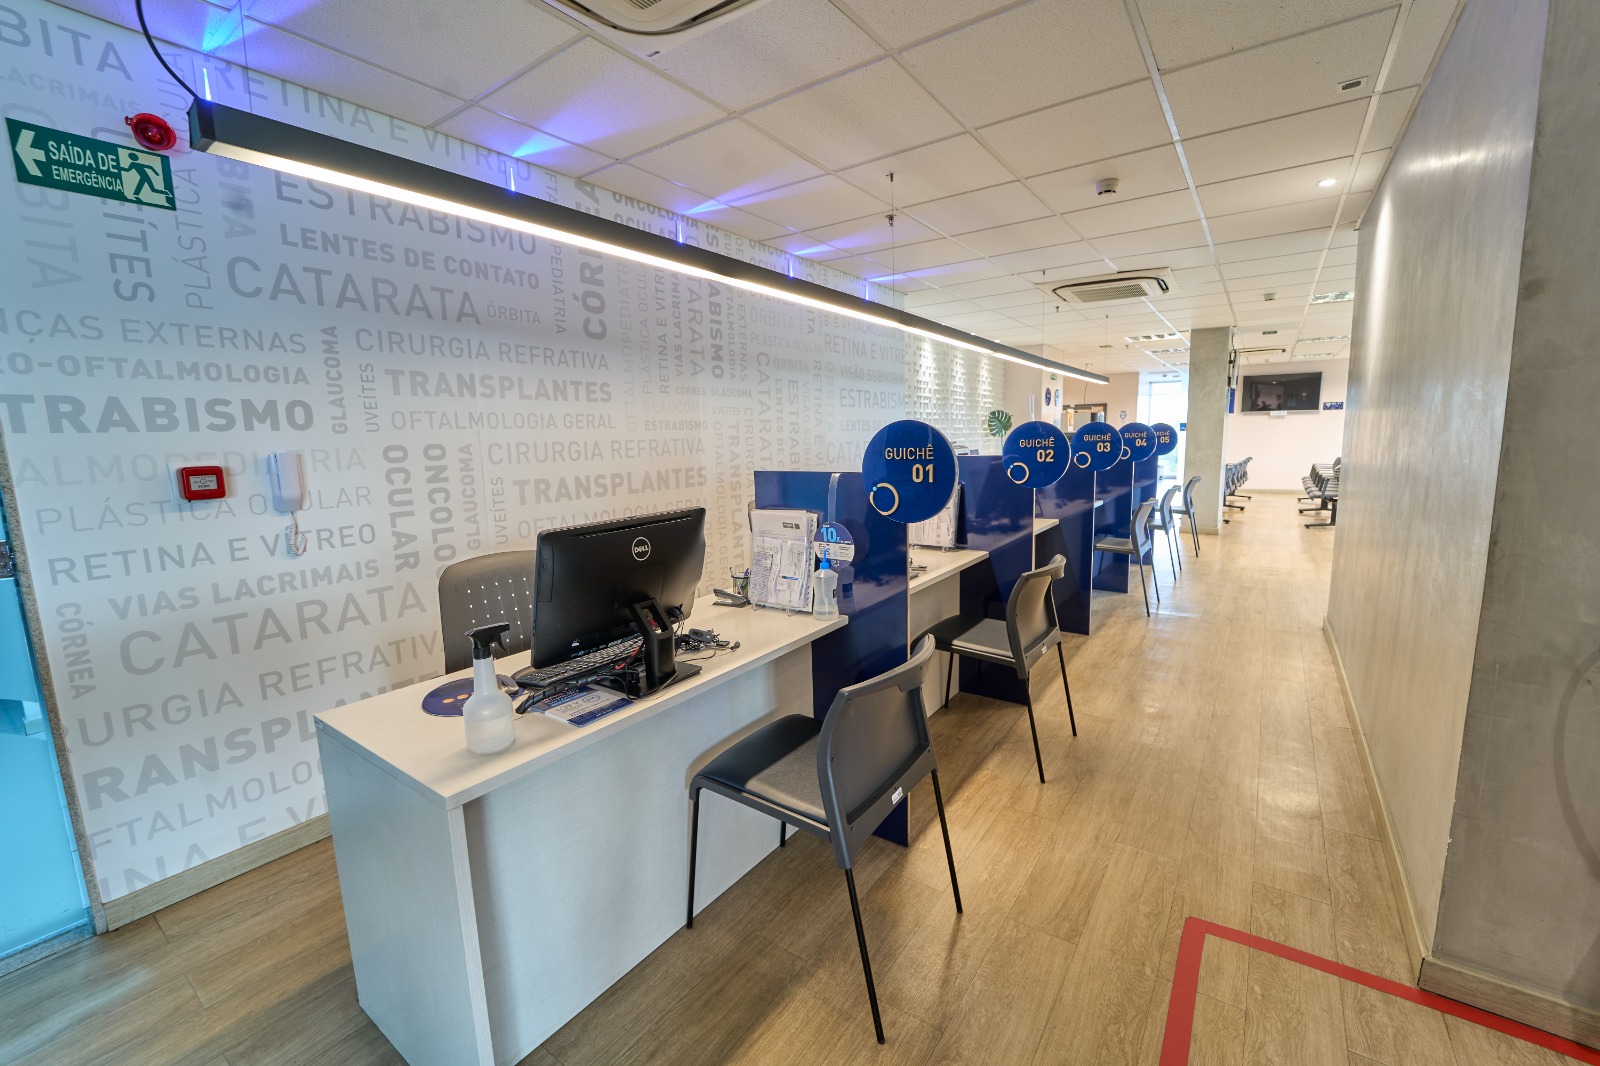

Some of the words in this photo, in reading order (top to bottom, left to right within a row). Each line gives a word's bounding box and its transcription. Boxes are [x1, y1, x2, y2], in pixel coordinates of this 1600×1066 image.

[0, 66, 141, 116] ACRIMAIS
[389, 117, 409, 143] E
[48, 140, 95, 168] SAÍDA
[99, 152, 119, 173] DE
[52, 166, 124, 193] EMERGÊNCIA
[274, 170, 537, 255] ESTRABISMO
[171, 167, 214, 311] PLÁSTICA
[280, 223, 396, 263] LENTES
[404, 247, 435, 271] DE
[444, 256, 539, 289] CONTATO
[226, 256, 482, 325] CATARATA
[487, 300, 541, 325] ÓRBITA
[657, 317, 667, 327] E
[750, 300, 796, 330] ÓRBITA
[120, 318, 306, 353] EXTERNAS
[355, 328, 491, 360] CIRURGIA
[499, 342, 609, 371] REFRATIVA
[738, 304, 748, 381] EXTERNAS
[751, 332, 791, 351] PLÁSTICA
[794, 339, 823, 354] OCULAR
[824, 333, 867, 358] RETINA
[871, 342, 877, 360] E
[0, 352, 310, 386] O-OFTALMOLOGIA
[637, 318, 653, 394] PLÁSTICA
[656, 333, 670, 394] RETINA
[674, 343, 684, 377] VIAS
[773, 353, 810, 374] ÓRBITA
[839, 363, 865, 380] VISÃO
[320, 325, 348, 435] GLAUCOMA
[384, 368, 612, 403] TRANSPLANTES
[676, 383, 706, 396] CÓRNEA
[711, 386, 752, 399] GLAUCOMA
[813, 360, 823, 427] RETINA
[2, 393, 314, 434] TRABISMO
[358, 363, 380, 433] UVEÍTES
[643, 400, 707, 414] GLAUCOMA
[712, 404, 740, 416] UVEÍTES
[756, 352, 773, 471] CATARAT
[775, 378, 784, 433] LENTES
[391, 411, 557, 430] OFTALMOLOGIA
[563, 413, 616, 431] GERAL
[645, 420, 708, 432] ESTRABISMO
[787, 379, 801, 471] ESTRAB
[840, 419, 871, 432] LENTES
[1083, 432, 1111, 441] GUICHÊ
[487, 441, 603, 465] CIRURGIA
[610, 437, 706, 460] REFRATIVA
[777, 438, 785, 456] DE
[885, 444, 934, 460] GUICHÊ
[1019, 437, 1055, 447] GUICHÊ
[1037, 450, 1054, 462] 02
[1097, 442, 1111, 452] 03
[1135, 438, 1147, 447] 04
[512, 466, 708, 506] TRANSPLANTES
[714, 422, 728, 541] OFTALMOLOGIA
[912, 464, 934, 483] 01
[36, 485, 237, 535] PLÁSTICA
[249, 486, 372, 516] OULAR
[382, 444, 421, 574] OCULAR
[458, 443, 482, 551] GLAUCOMA
[490, 476, 509, 545] UVEÍTES
[48, 542, 216, 586] RETINA
[228, 537, 249, 562] E
[107, 586, 200, 621] VIAS
[212, 559, 380, 604] LACRIMAIS
[120, 581, 427, 675] CATARATA
[55, 602, 97, 700] CÓRNEA
[66, 681, 245, 753] URGIA
[258, 630, 444, 701] REFRATIV
[88, 757, 323, 860] FTALMOLO
